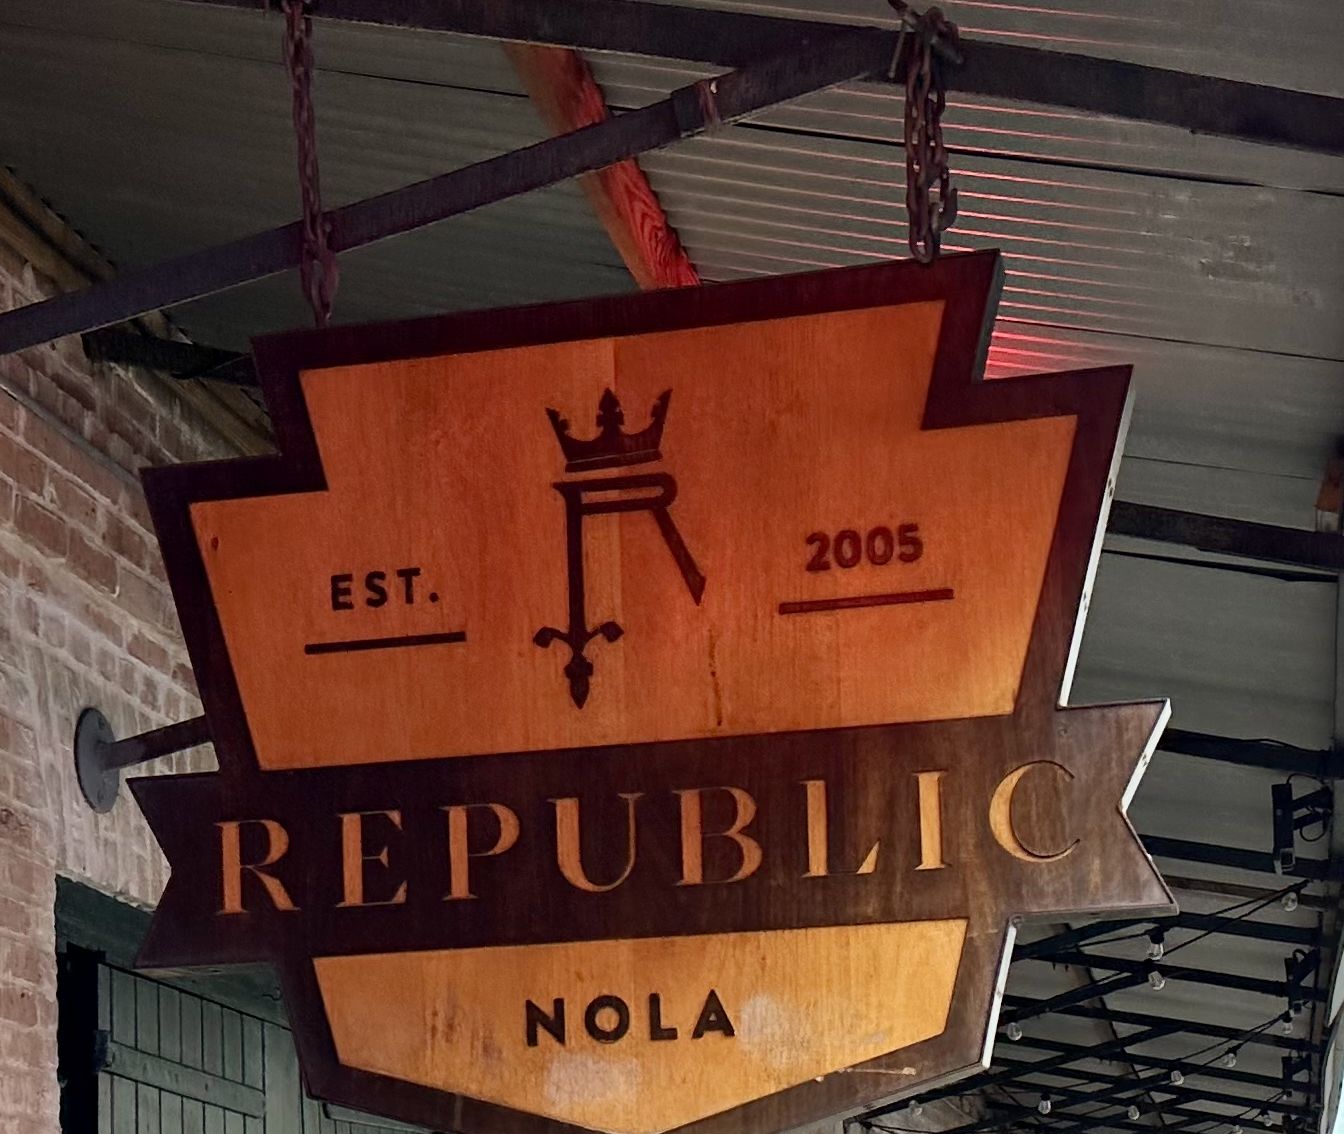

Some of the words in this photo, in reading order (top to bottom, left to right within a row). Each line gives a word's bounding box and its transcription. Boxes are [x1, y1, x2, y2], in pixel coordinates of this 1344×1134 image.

[805, 522, 925, 572] 2005
[330, 567, 441, 611] EST.
[214, 760, 1082, 917] REPUBLIC
[524, 989, 736, 1048] NOLA
